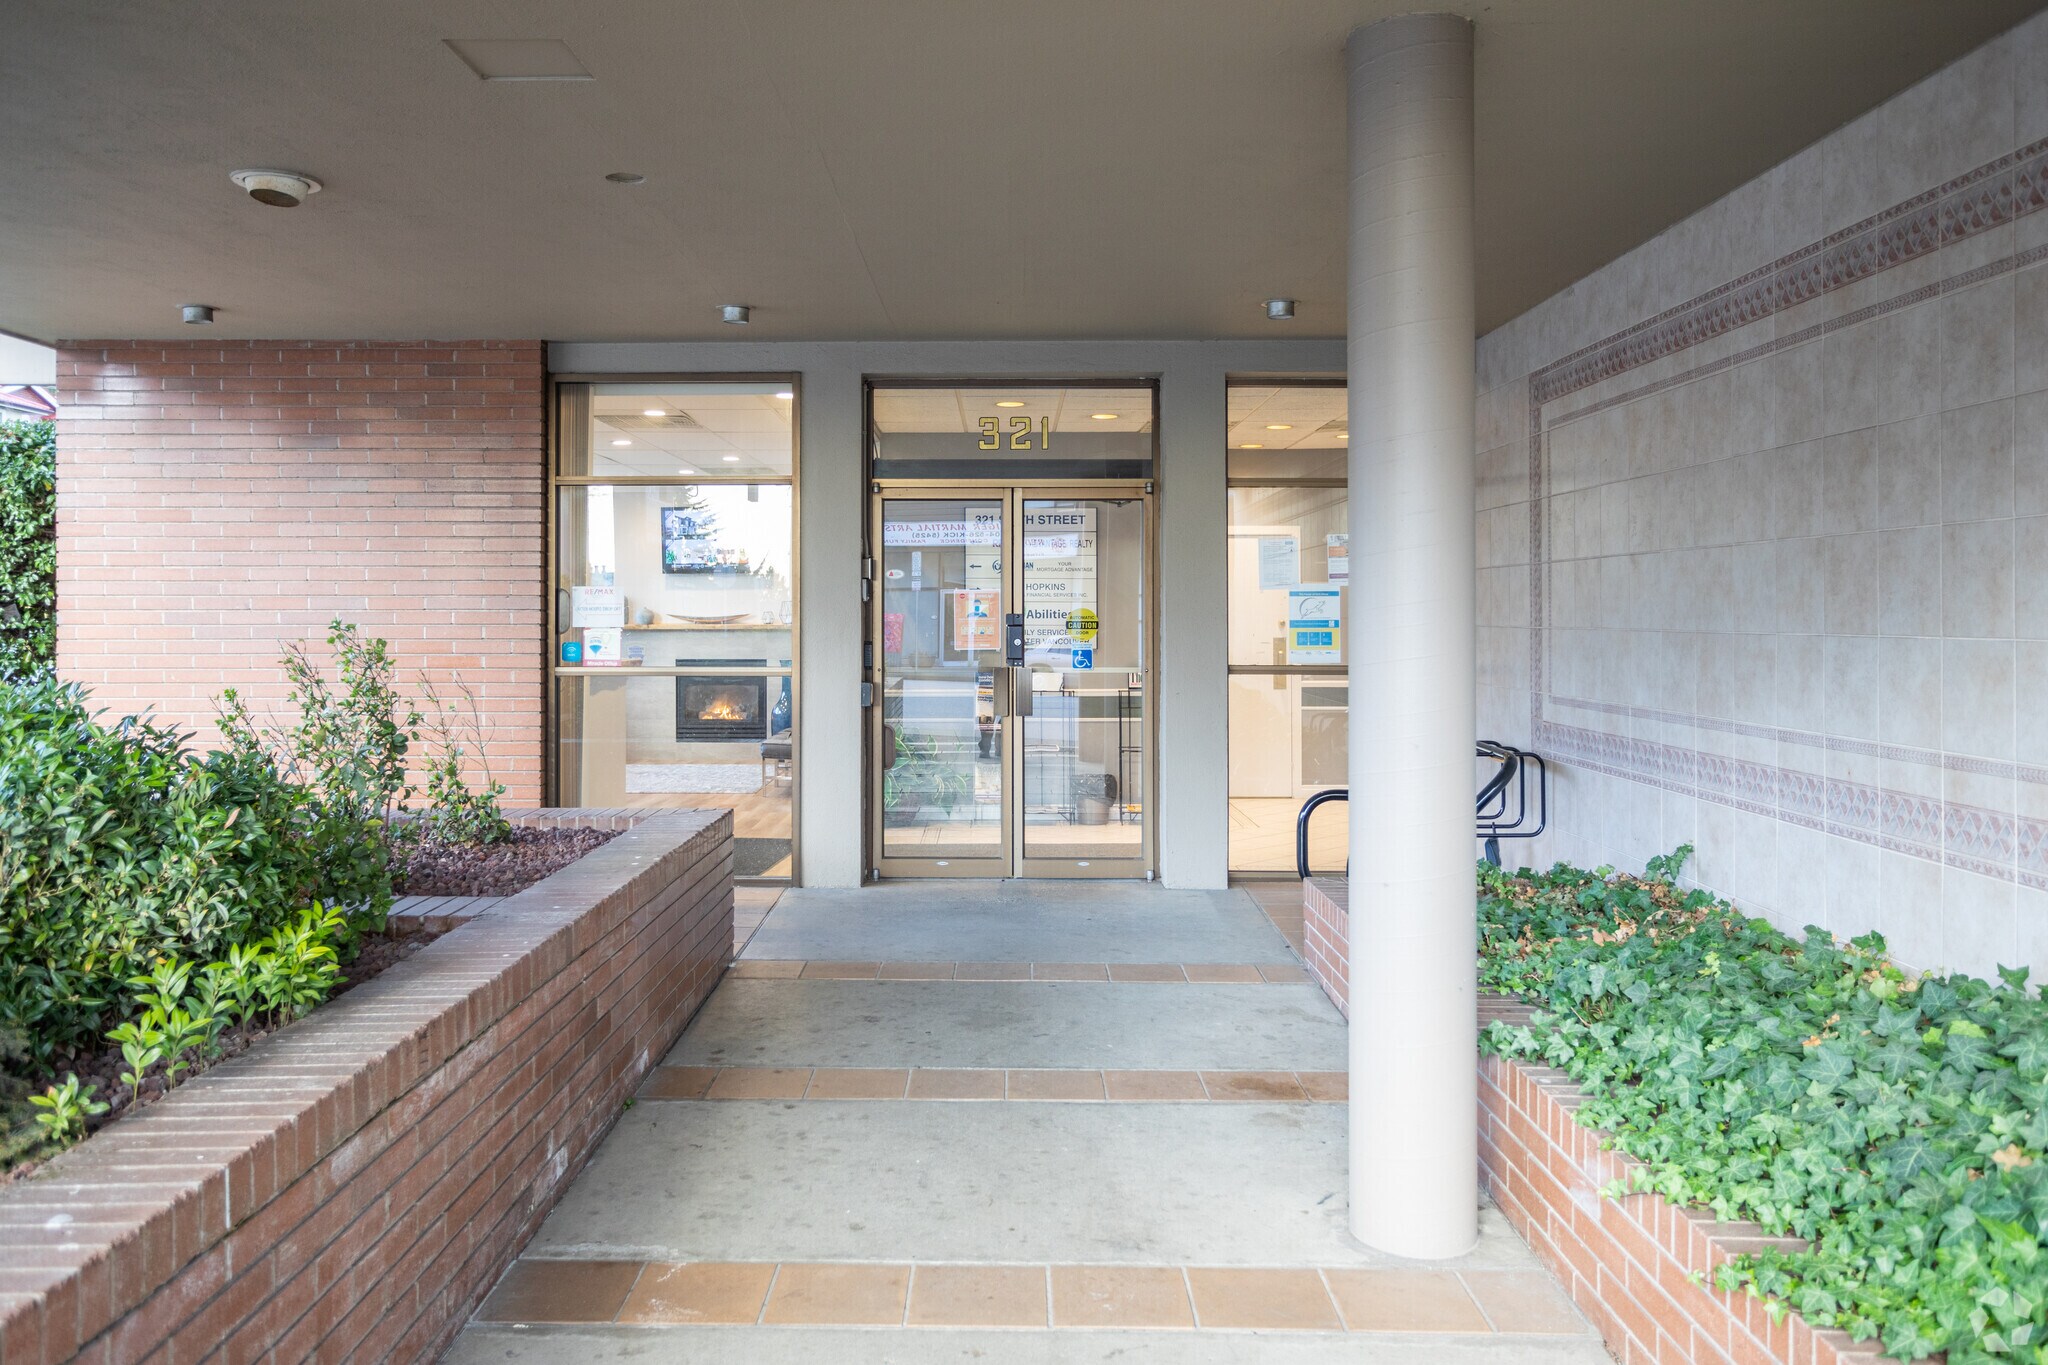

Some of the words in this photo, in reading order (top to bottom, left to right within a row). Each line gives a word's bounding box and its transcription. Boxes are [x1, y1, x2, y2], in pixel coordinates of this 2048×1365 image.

[978, 416, 1048, 450] 321
[975, 515, 994, 525] 321
[1038, 514, 1086, 525] STREET
[1025, 583, 1066, 591] HOPKINS
[1067, 621, 1097, 629] CAUTION
